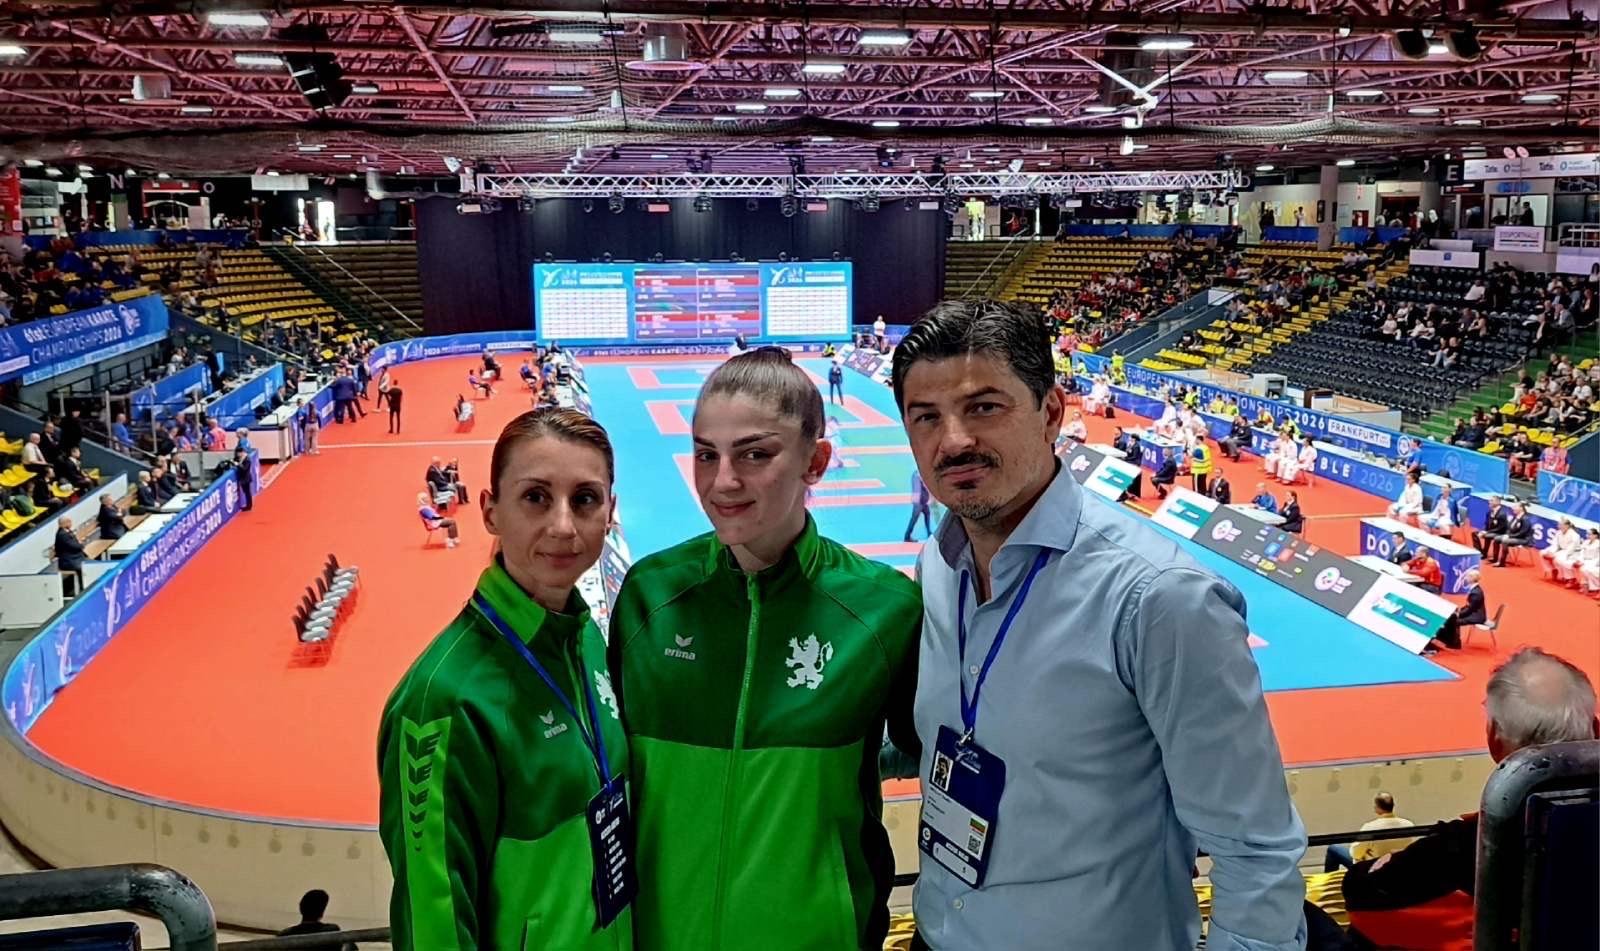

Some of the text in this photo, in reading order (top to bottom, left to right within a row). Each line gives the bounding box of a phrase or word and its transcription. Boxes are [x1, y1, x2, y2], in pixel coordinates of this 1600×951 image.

[24, 326, 46, 343] 61st
[44, 317, 88, 338] EUROPEAN
[1294, 411, 1325, 430] 2026
[1330, 420, 1380, 444] FRANKFURT
[157, 510, 197, 556] EUROPEAN
[664, 647, 696, 661] erima
